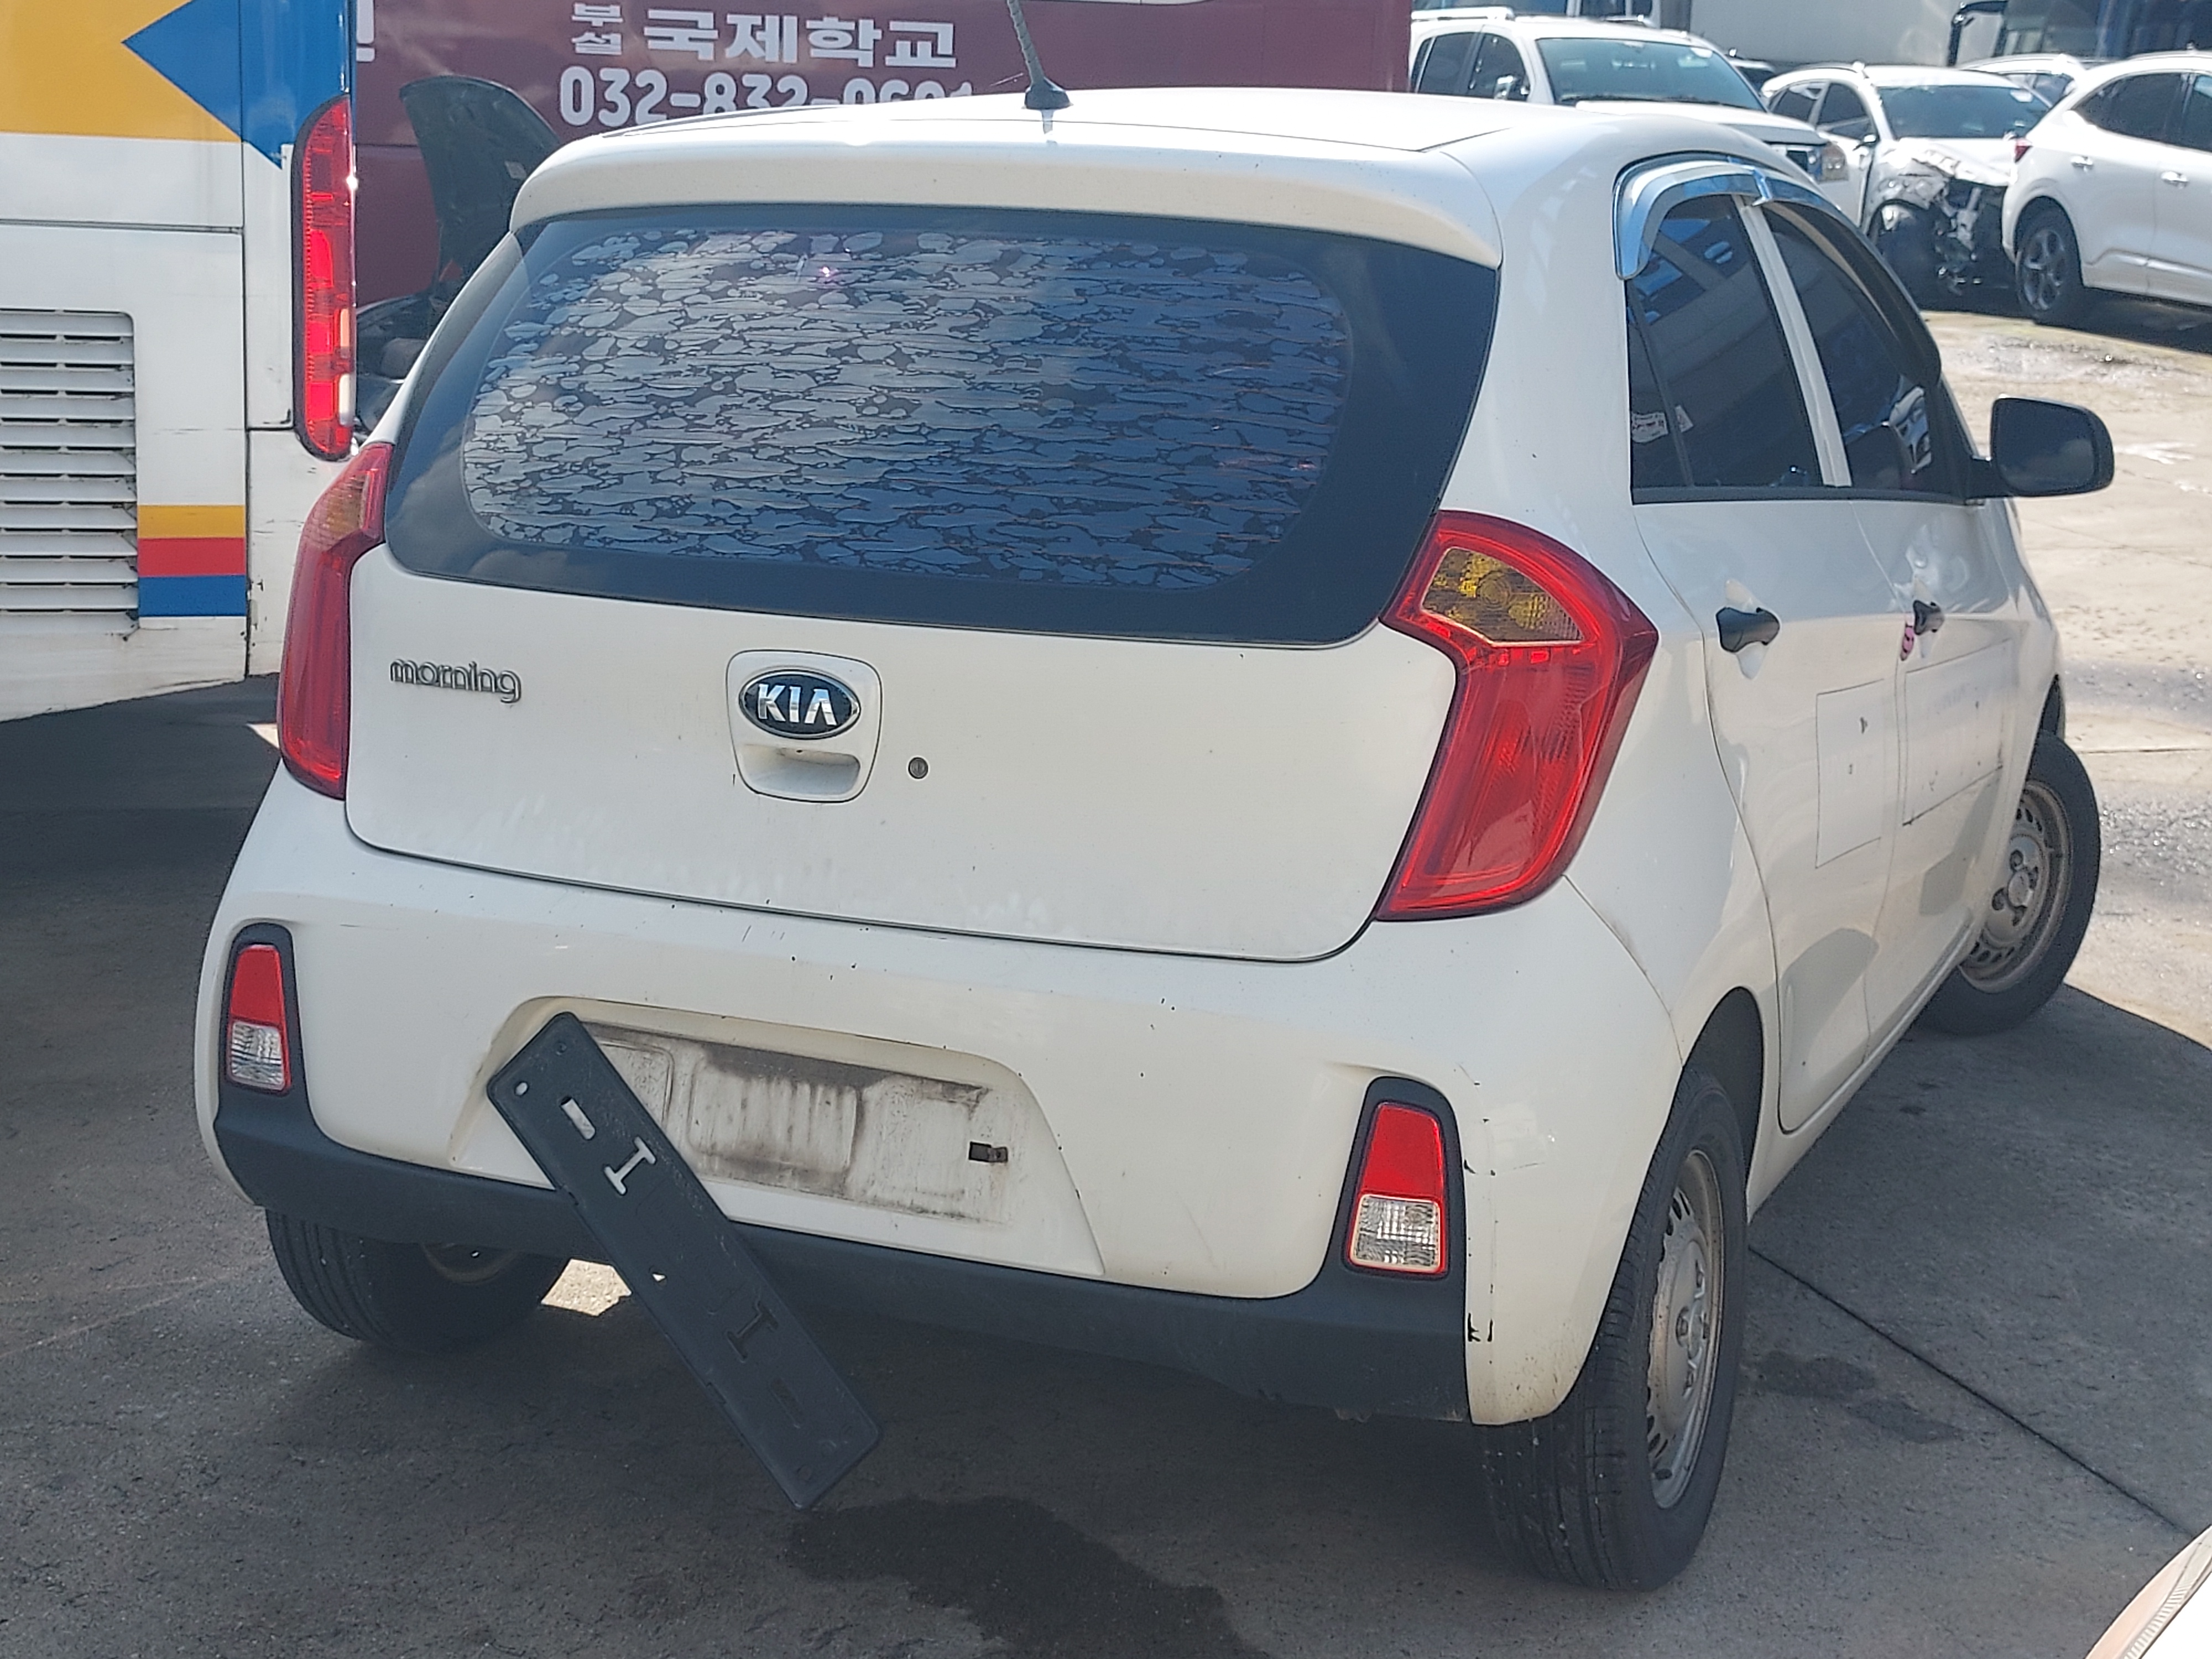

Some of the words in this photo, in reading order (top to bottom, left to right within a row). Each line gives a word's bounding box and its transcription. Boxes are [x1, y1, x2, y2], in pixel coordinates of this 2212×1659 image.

[571, 3, 623, 55] 부설
[644, 8, 957, 68] 국제학교
[560, 66, 973, 127] 032-832-
[390, 659, 521, 703] morning
[758, 683, 837, 726] KIA
